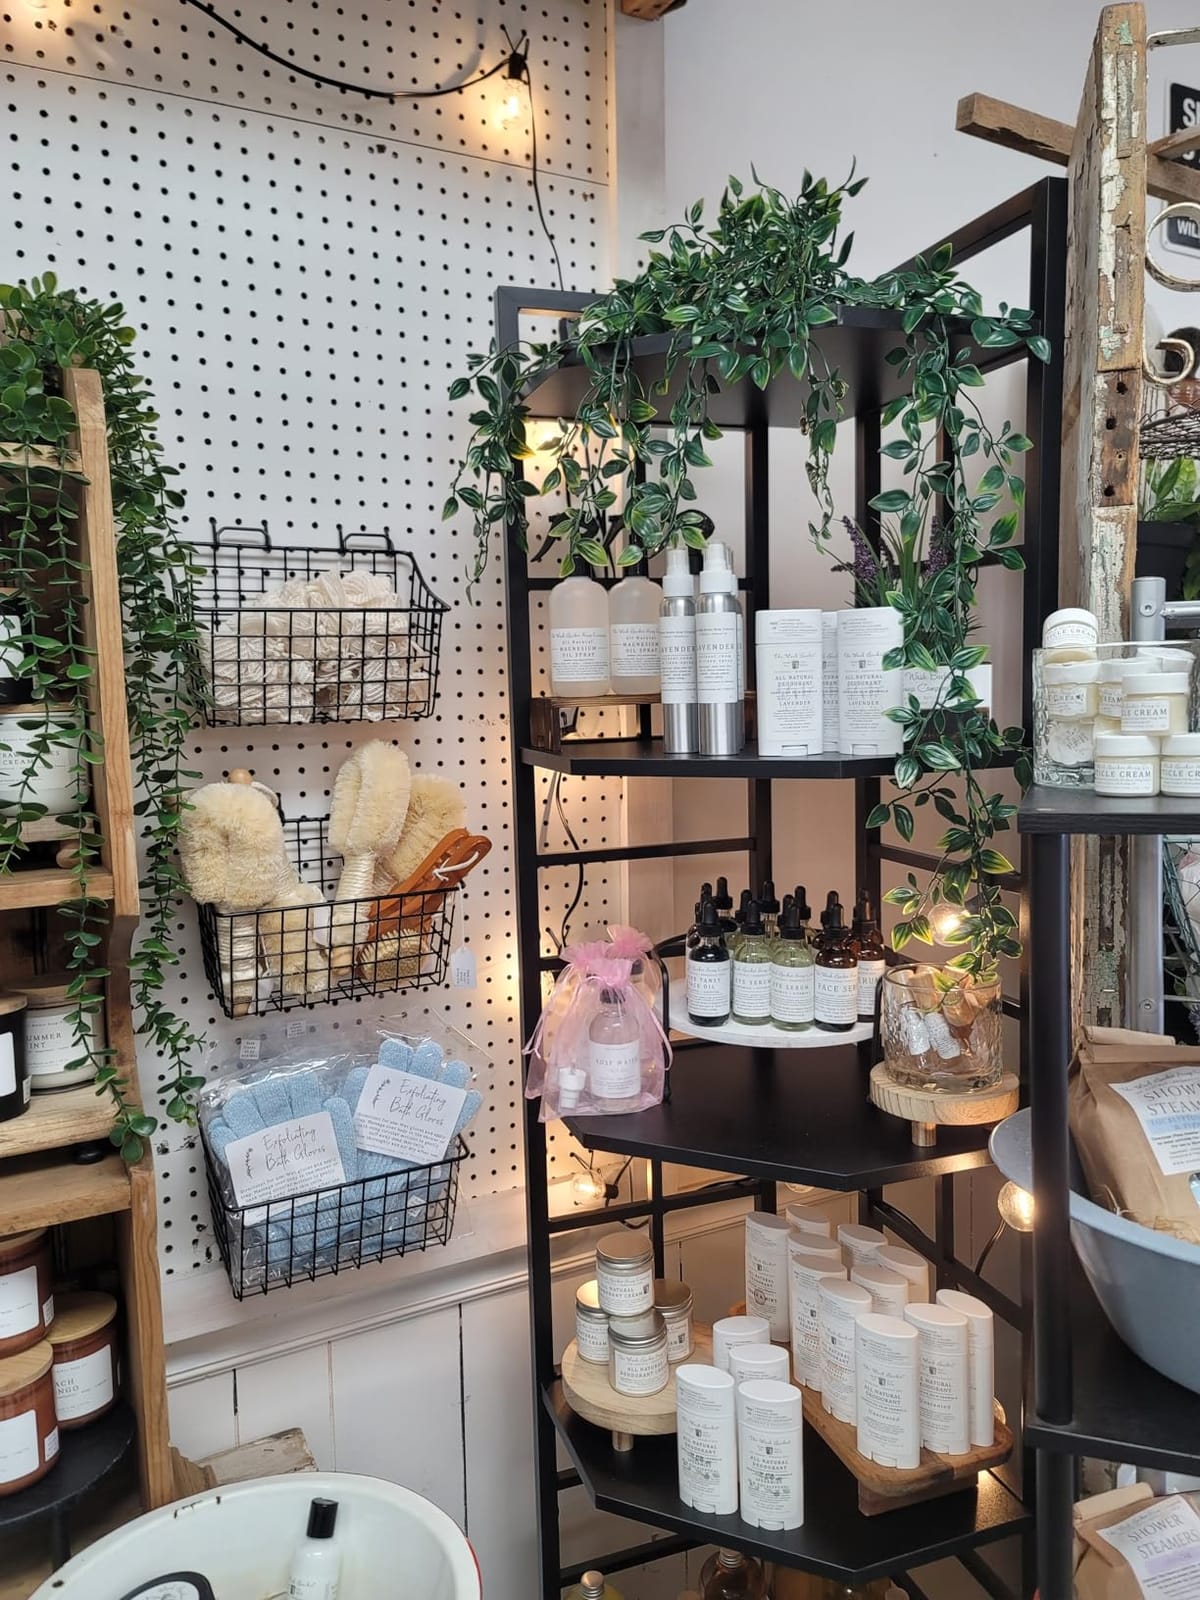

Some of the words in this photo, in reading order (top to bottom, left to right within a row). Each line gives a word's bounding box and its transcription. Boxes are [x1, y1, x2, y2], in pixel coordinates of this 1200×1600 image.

[1134, 708, 1168, 717] CREAM
[1119, 770, 1151, 778] CREAM
[818, 983, 839, 992] FACE
[400, 1079, 447, 1112] Exfoliating
[1144, 1082, 1200, 1101] SHOW
[390, 1096, 413, 1119] Bath
[263, 1125, 316, 1151] Exfoliating
[265, 1151, 290, 1171] Bath
[875, 1388, 901, 1399] NATURAL
[1128, 1513, 1185, 1543] SHOWER
